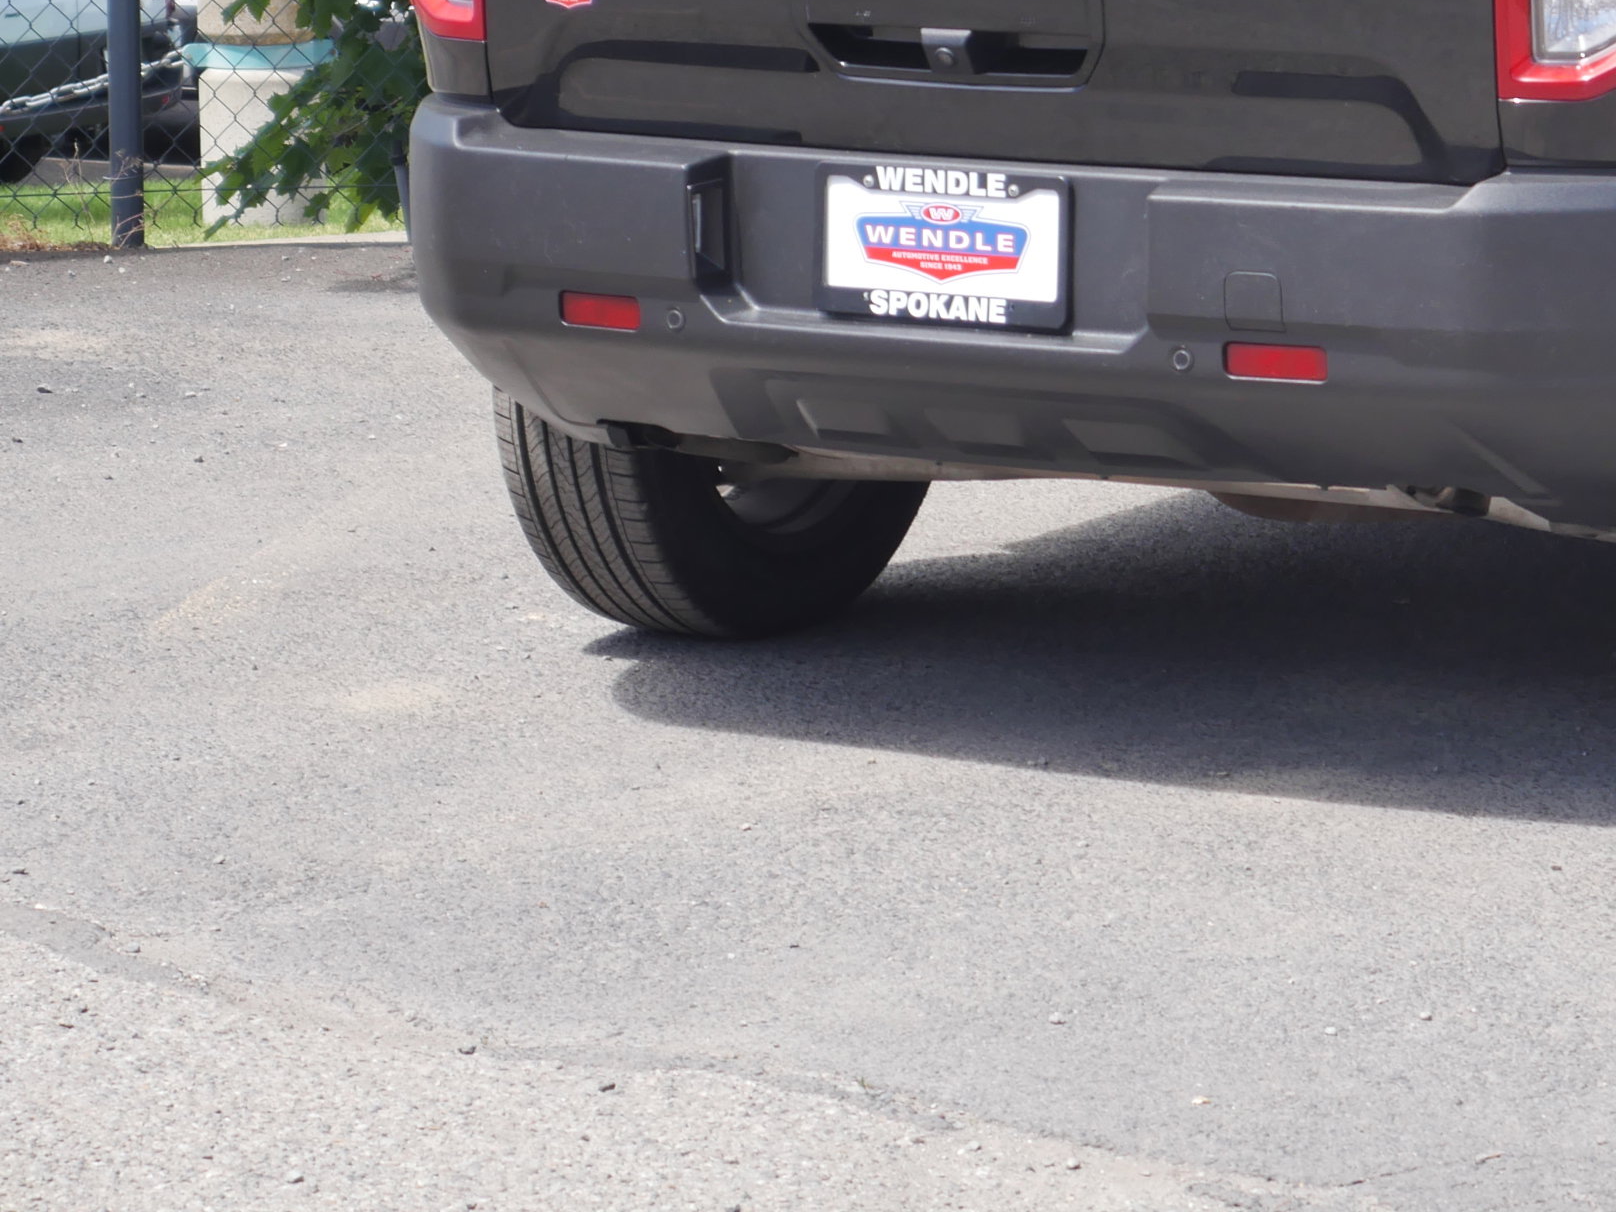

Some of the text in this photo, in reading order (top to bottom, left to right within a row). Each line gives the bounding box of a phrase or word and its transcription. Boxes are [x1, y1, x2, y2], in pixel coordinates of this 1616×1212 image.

[875, 165, 1007, 199] WENDLE
[864, 224, 1015, 253] WENDLE
[891, 250, 989, 265] AUTOMOTIVE EXCELLENCE
[919, 261, 943, 270] SINCE
[868, 289, 1007, 324] SPOKANE
